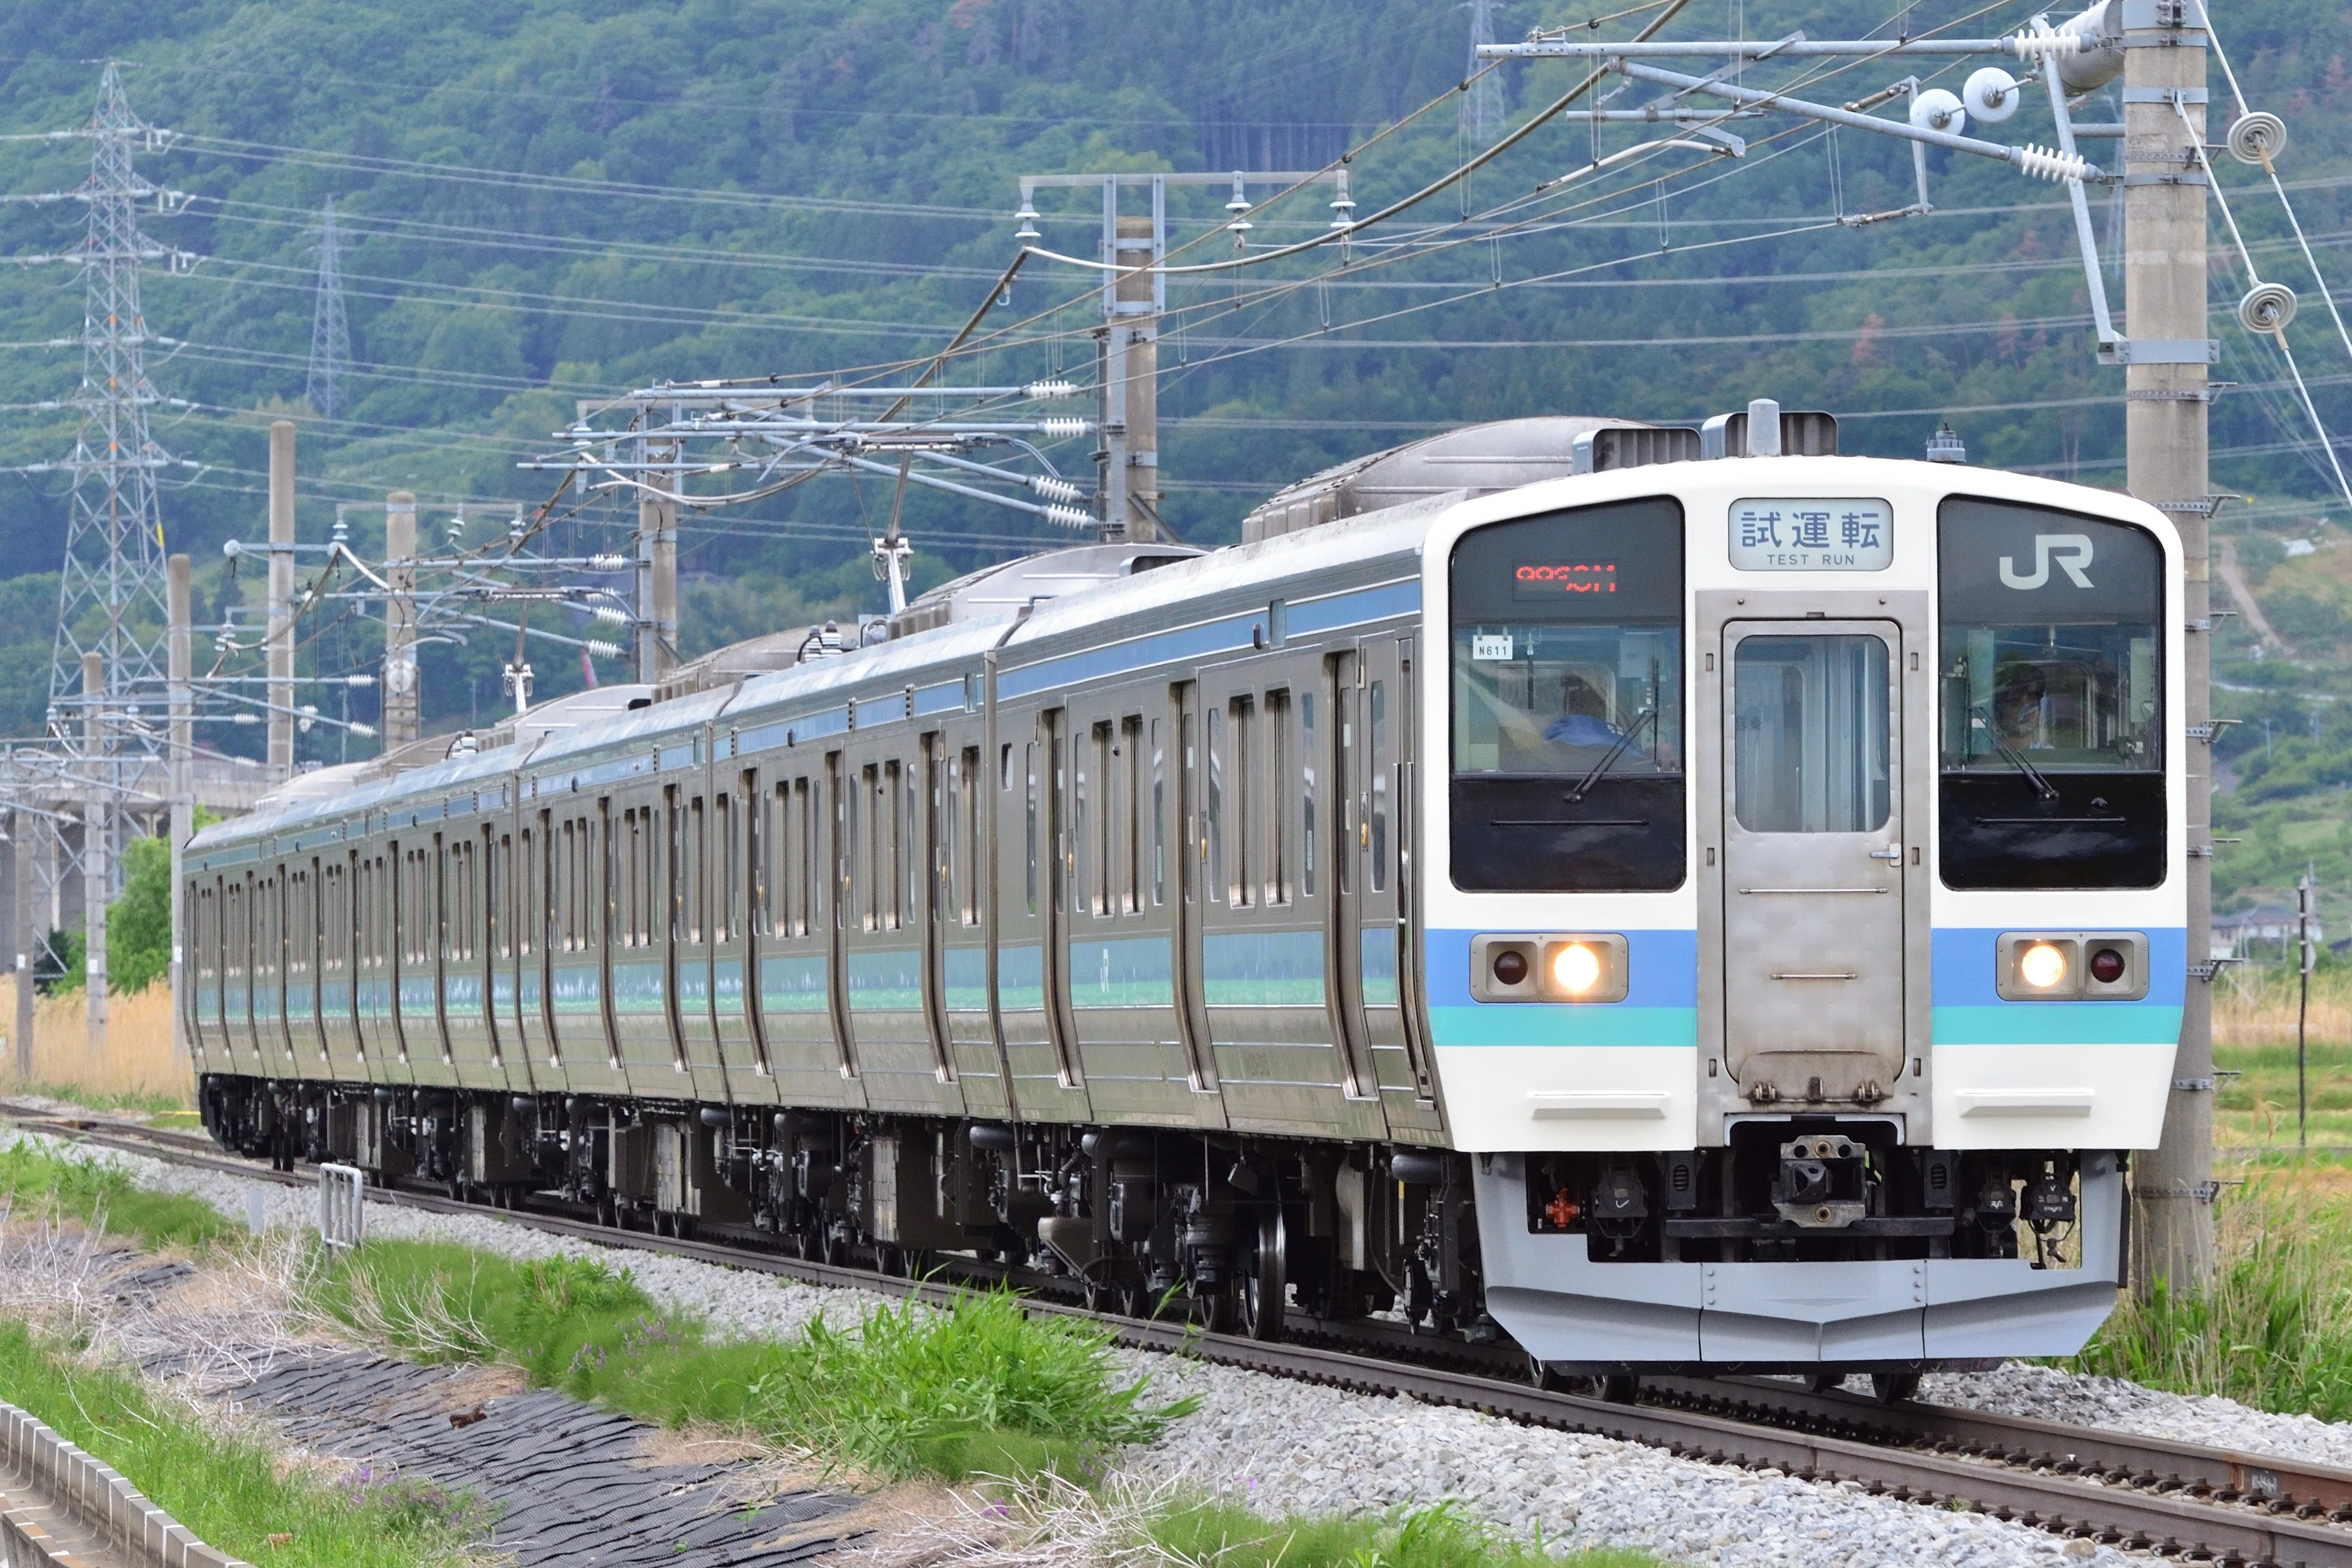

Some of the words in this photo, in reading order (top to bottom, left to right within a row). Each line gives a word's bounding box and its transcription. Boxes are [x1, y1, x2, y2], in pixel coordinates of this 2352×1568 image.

[1740, 511, 1880, 548] 試運転
[1767, 553, 1809, 565] TEST
[1822, 553, 1855, 565] RUN
[1999, 533, 2095, 590] JR
[1479, 645, 1507, 656] N611
